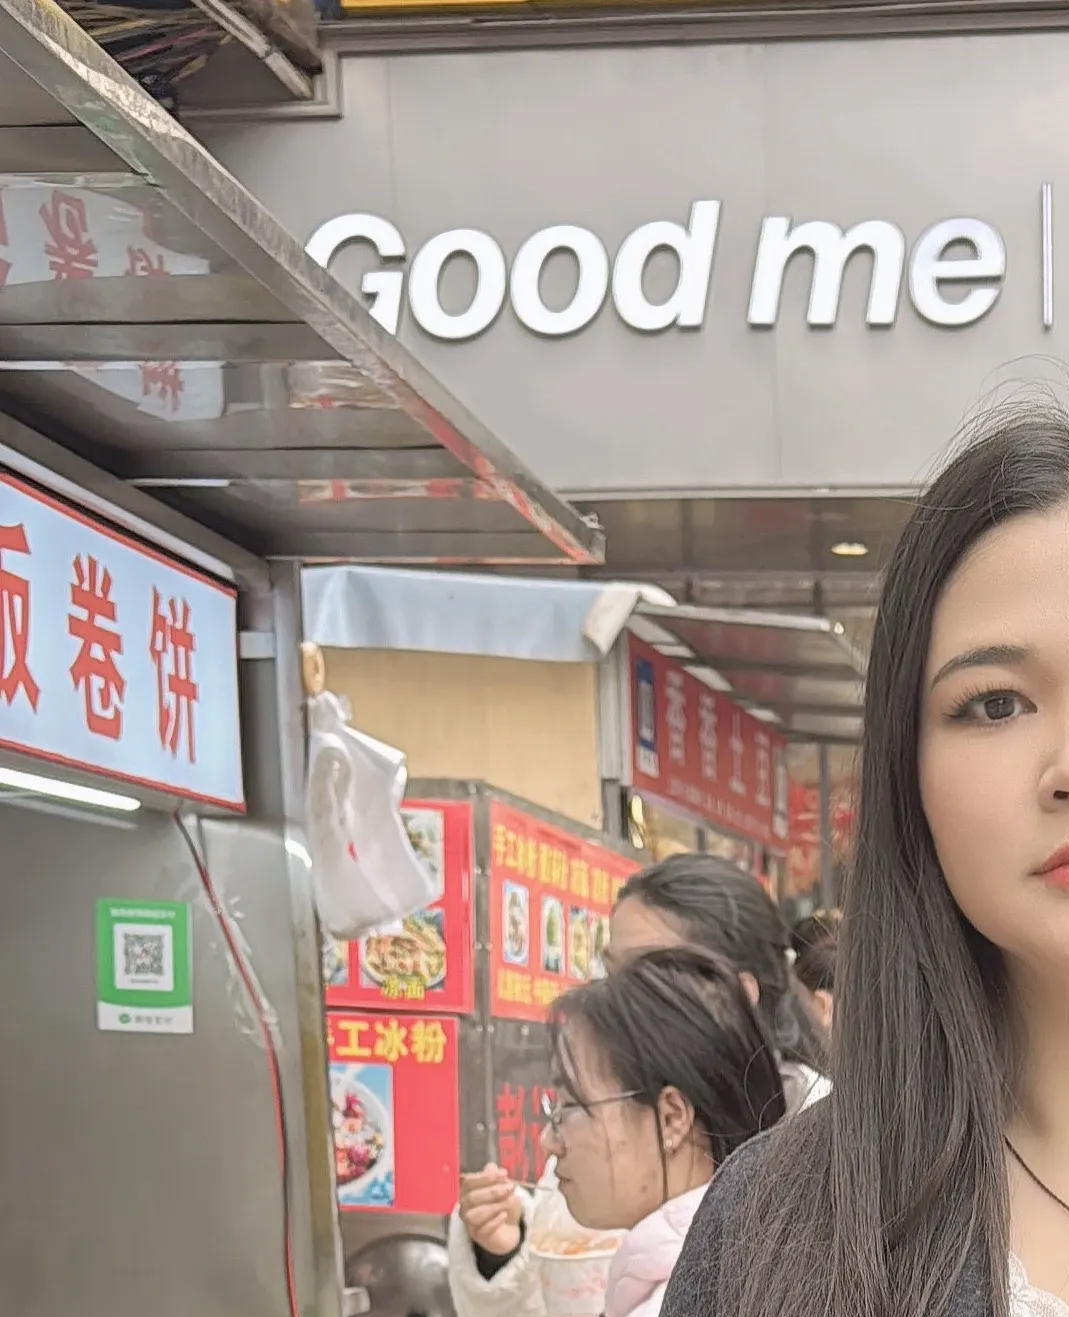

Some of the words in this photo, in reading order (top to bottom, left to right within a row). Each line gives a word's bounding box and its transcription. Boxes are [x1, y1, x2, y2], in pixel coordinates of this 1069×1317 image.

[305, 200, 721, 339] Good
[747, 215, 1006, 328] me
[327, 1017, 447, 1064] 工冰粉
